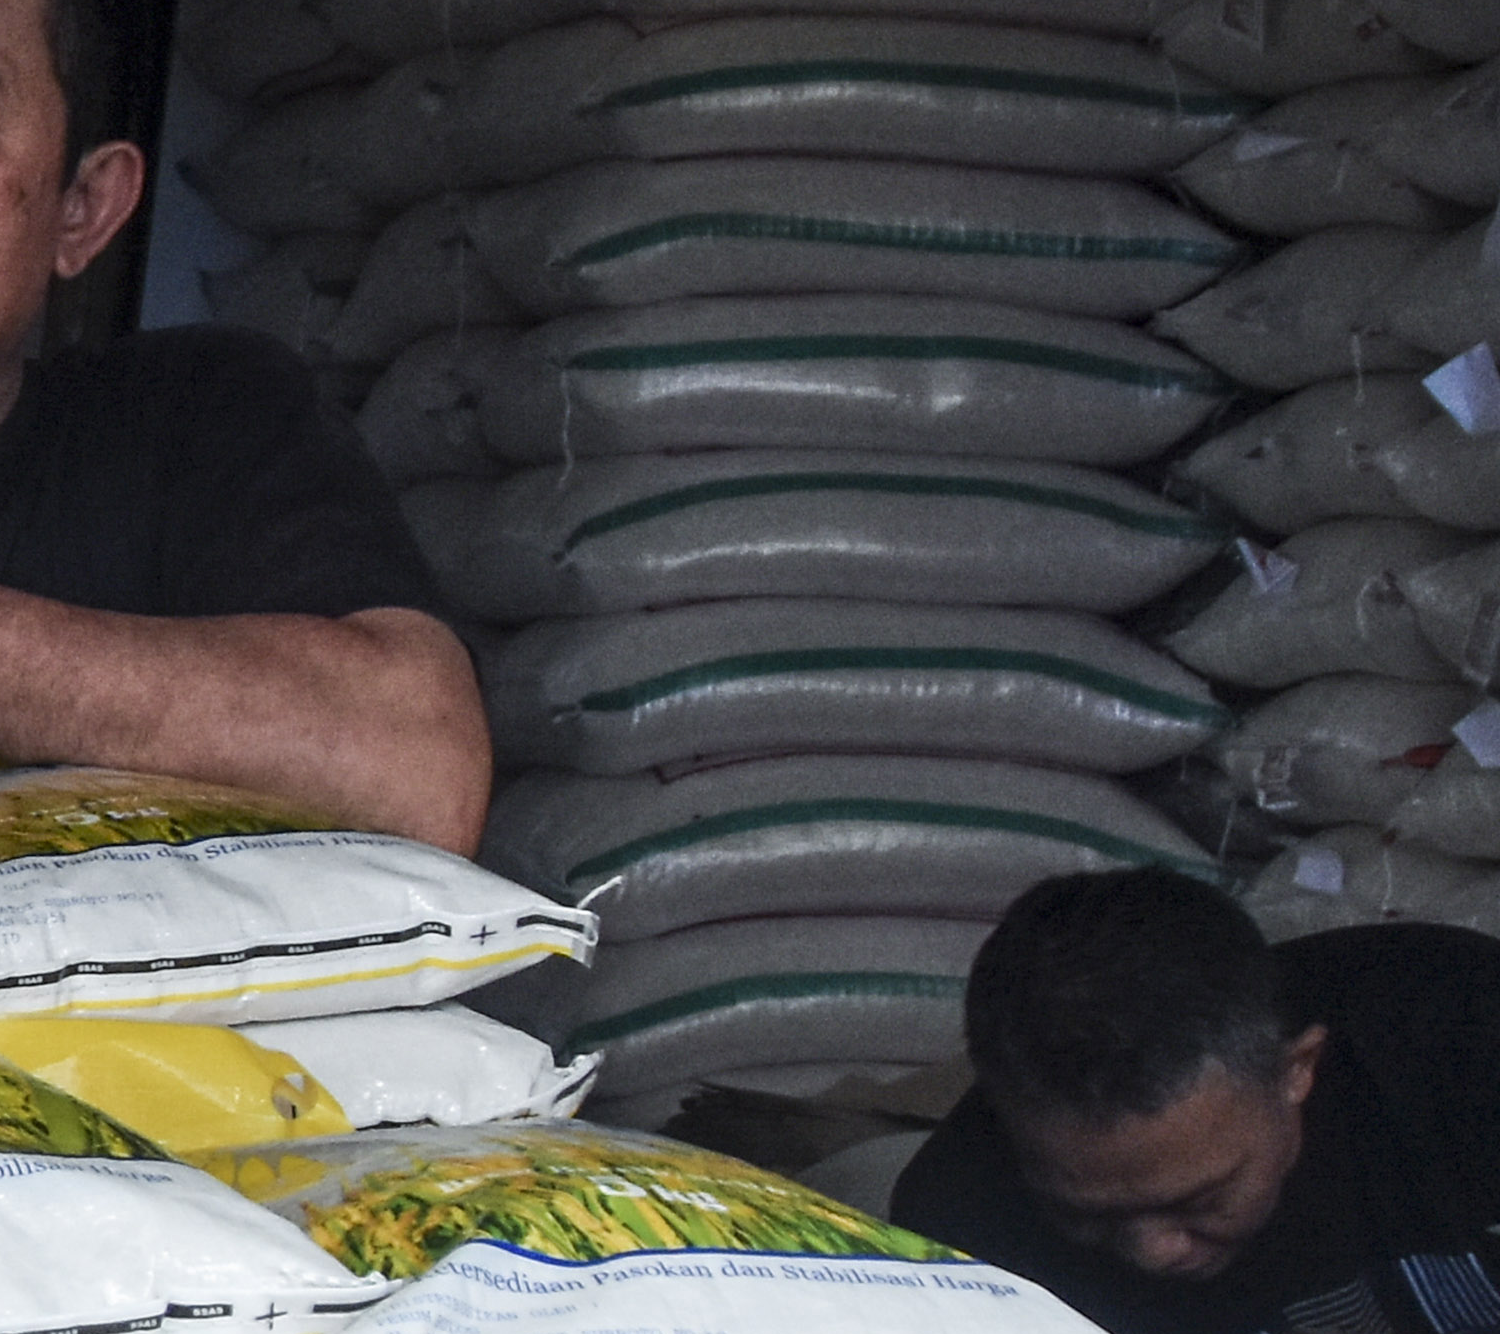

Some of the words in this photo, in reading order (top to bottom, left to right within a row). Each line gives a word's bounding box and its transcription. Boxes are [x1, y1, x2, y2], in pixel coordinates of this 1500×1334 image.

[204, 834, 327, 861] Stabilisasi
[594, 1262, 714, 1287] Pasokan
[720, 1259, 777, 1280] dan
[782, 1262, 926, 1290] Stabilisasi
[931, 1272, 1018, 1299] Harga
